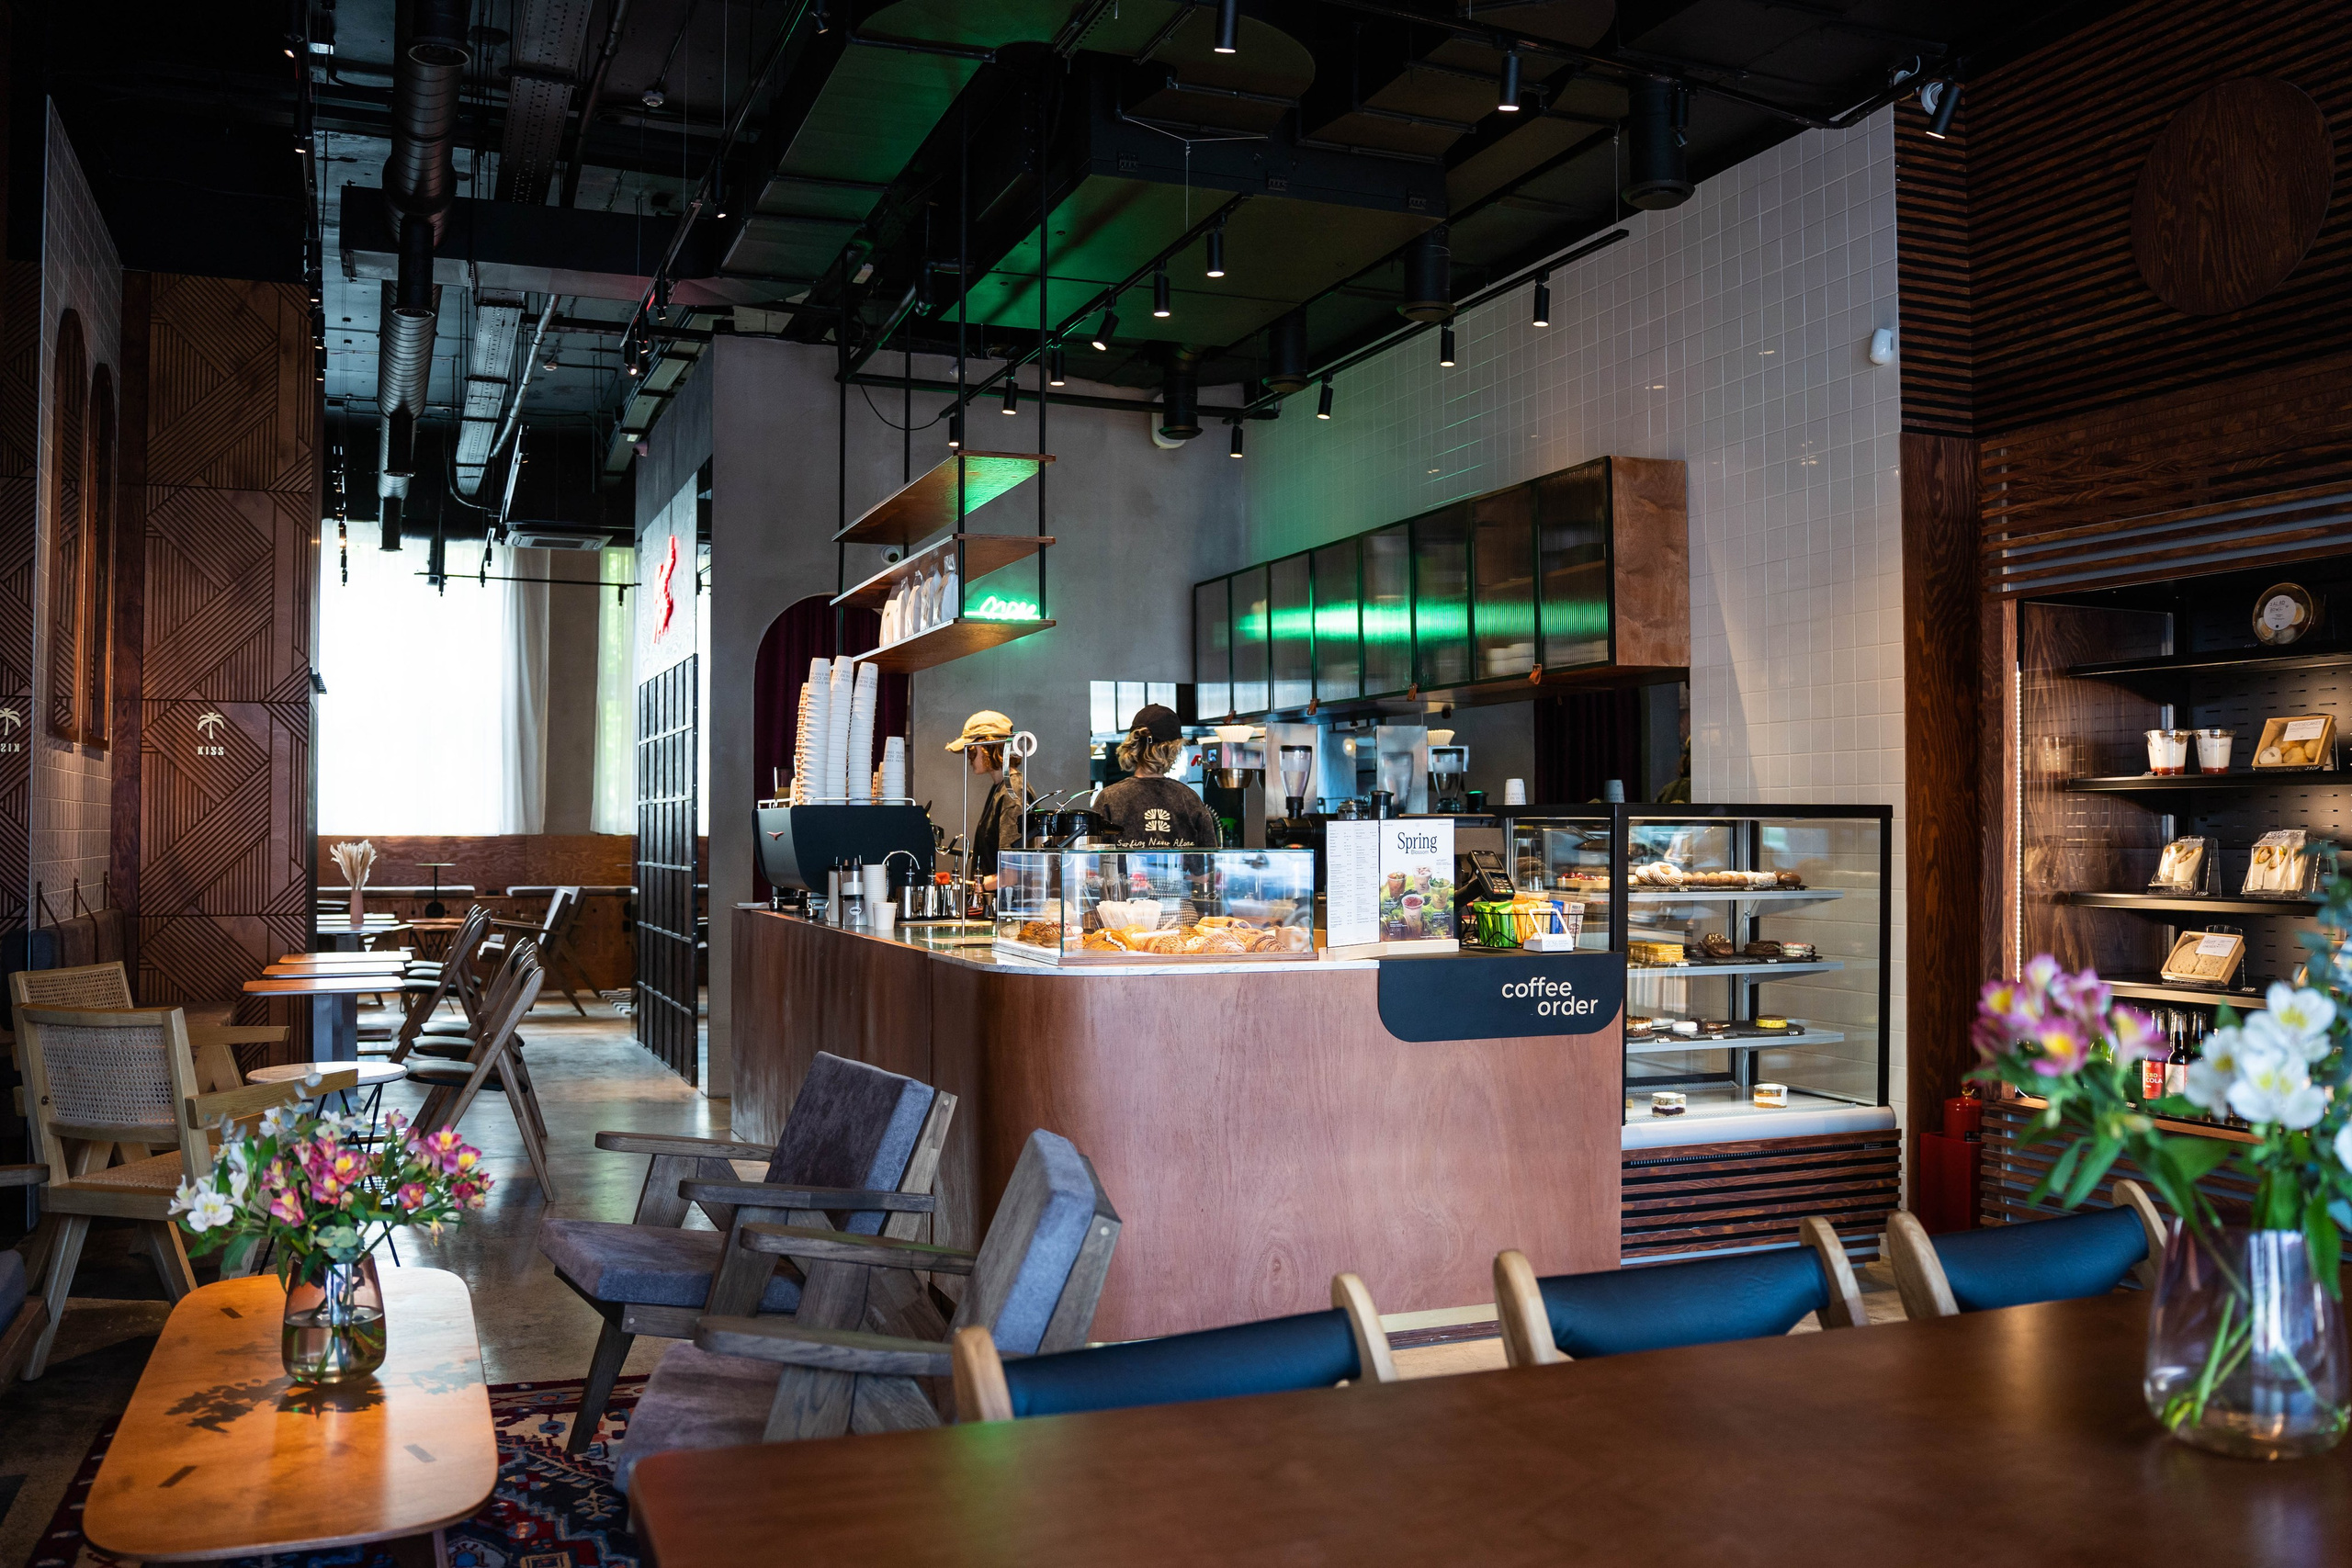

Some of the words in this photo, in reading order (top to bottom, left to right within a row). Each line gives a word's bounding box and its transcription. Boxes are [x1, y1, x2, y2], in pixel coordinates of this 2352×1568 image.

[198, 746, 224, 756] KISS
[1116, 839, 1146, 849] Surfing
[1148, 837, 1170, 846] Never
[1173, 838, 1195, 847] Alone
[1397, 831, 1438, 854] Spring
[1501, 976, 1572, 998] coffee
[1537, 996, 1599, 1016] order
